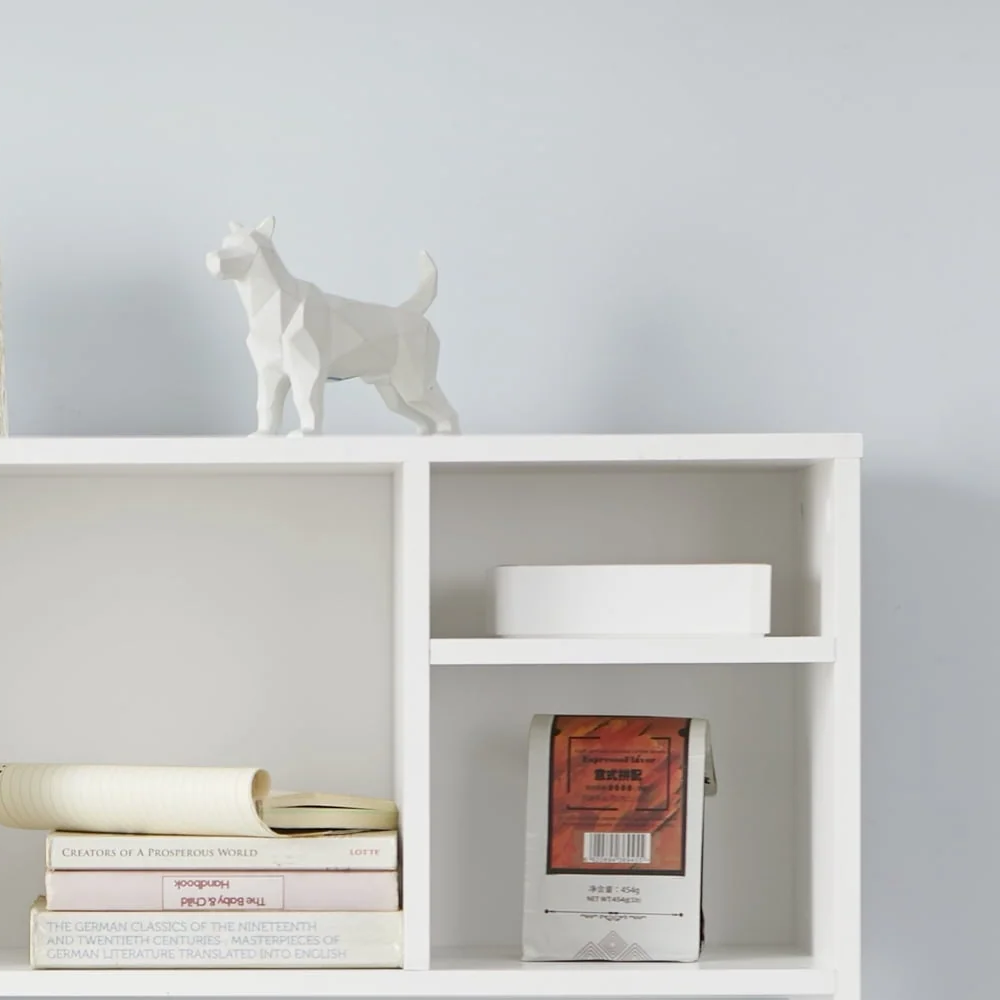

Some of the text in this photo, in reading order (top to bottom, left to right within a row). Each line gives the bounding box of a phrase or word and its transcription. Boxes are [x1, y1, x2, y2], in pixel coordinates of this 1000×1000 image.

[62, 847, 258, 858] CREATORS OF A PROSPEROUS WORLD
[174, 879, 230, 889] Handbook
[181, 894, 265, 907] The Baby & Child
[46, 921, 317, 932] THE GERMAN CLASSICS OF THE NINETEENTH
[47, 935, 74, 946] AND
[78, 935, 149, 946] TWENTIETH
[231, 935, 321, 946] MASTERPIECES
[322, 935, 341, 946] OF
[46, 949, 347, 960] GERMAN LITERATURE TRANSLATED INTO ENGLISH
